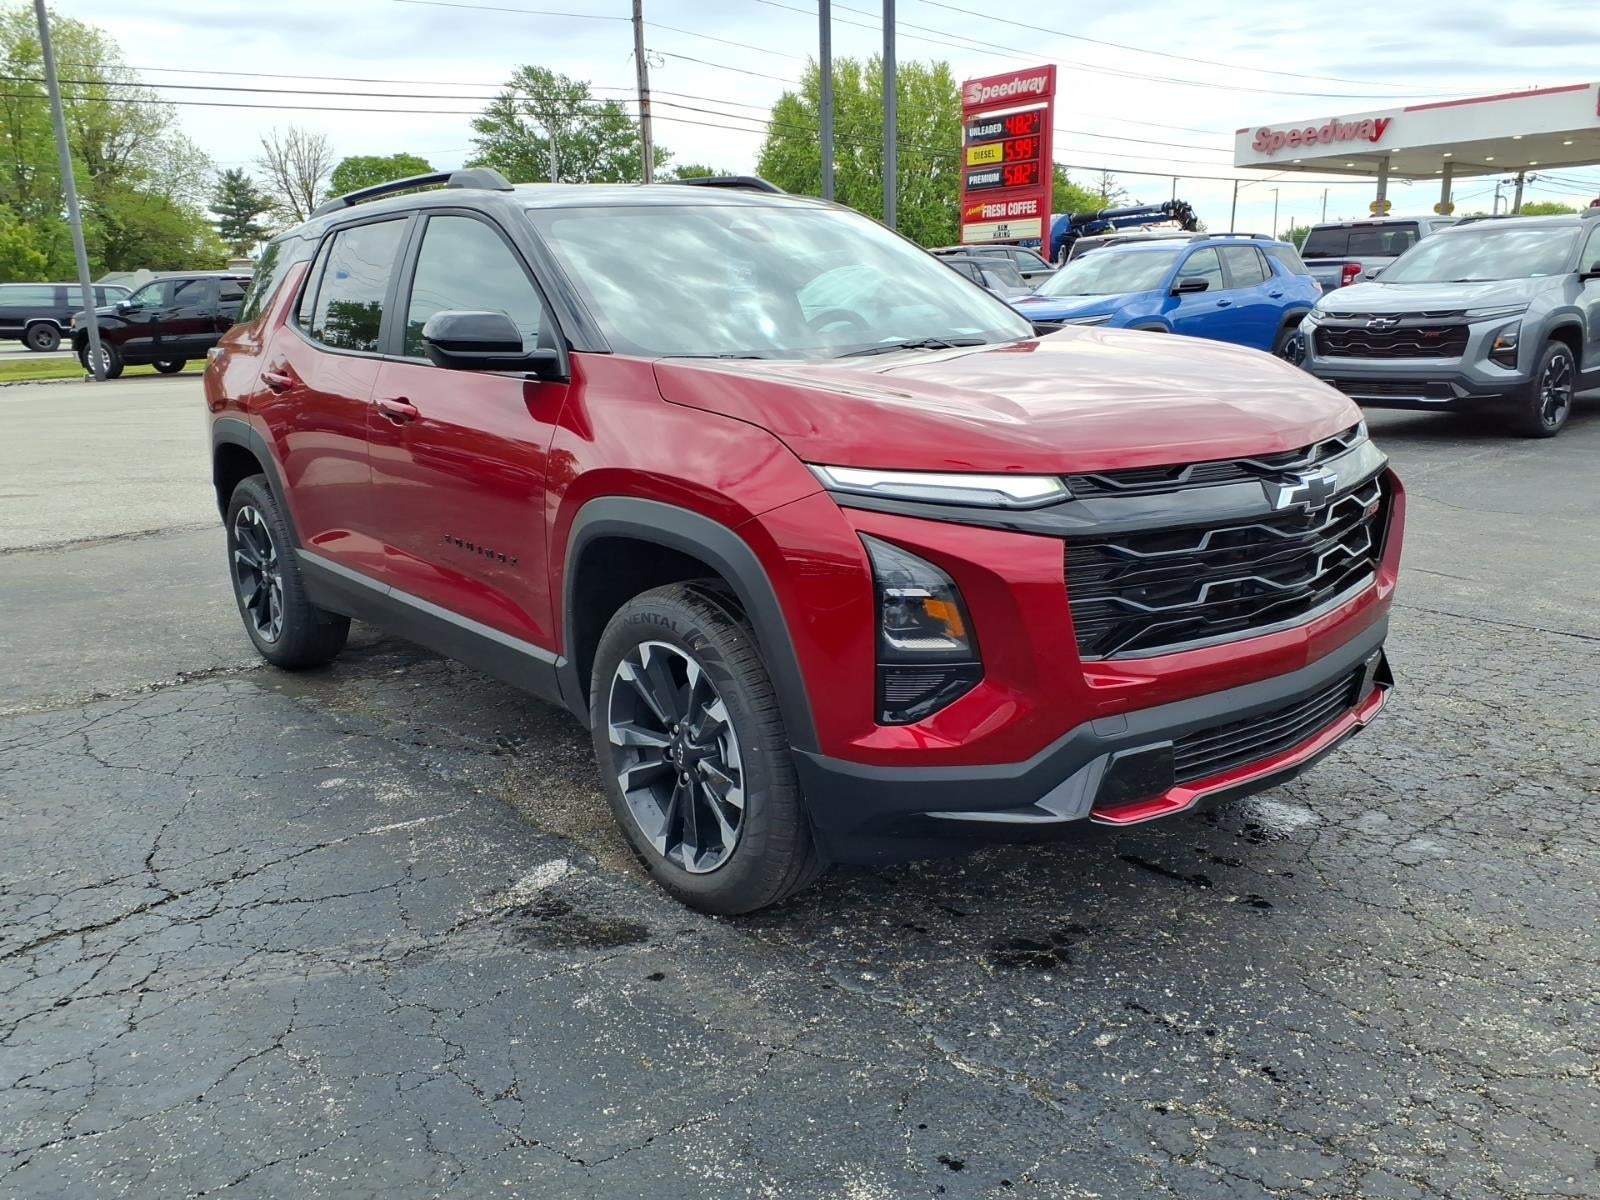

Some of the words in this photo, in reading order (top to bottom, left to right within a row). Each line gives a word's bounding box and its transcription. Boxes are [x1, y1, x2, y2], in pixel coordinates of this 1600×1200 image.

[968, 76, 1048, 103] Speedway
[969, 123, 1002, 137] UNLEADED
[1252, 117, 1391, 155] Speedway
[973, 149, 996, 160] DIESEL
[968, 173, 1000, 185] PREMIUM
[982, 203, 1006, 218] FRESH
[1007, 200, 1037, 216] COFFEE
